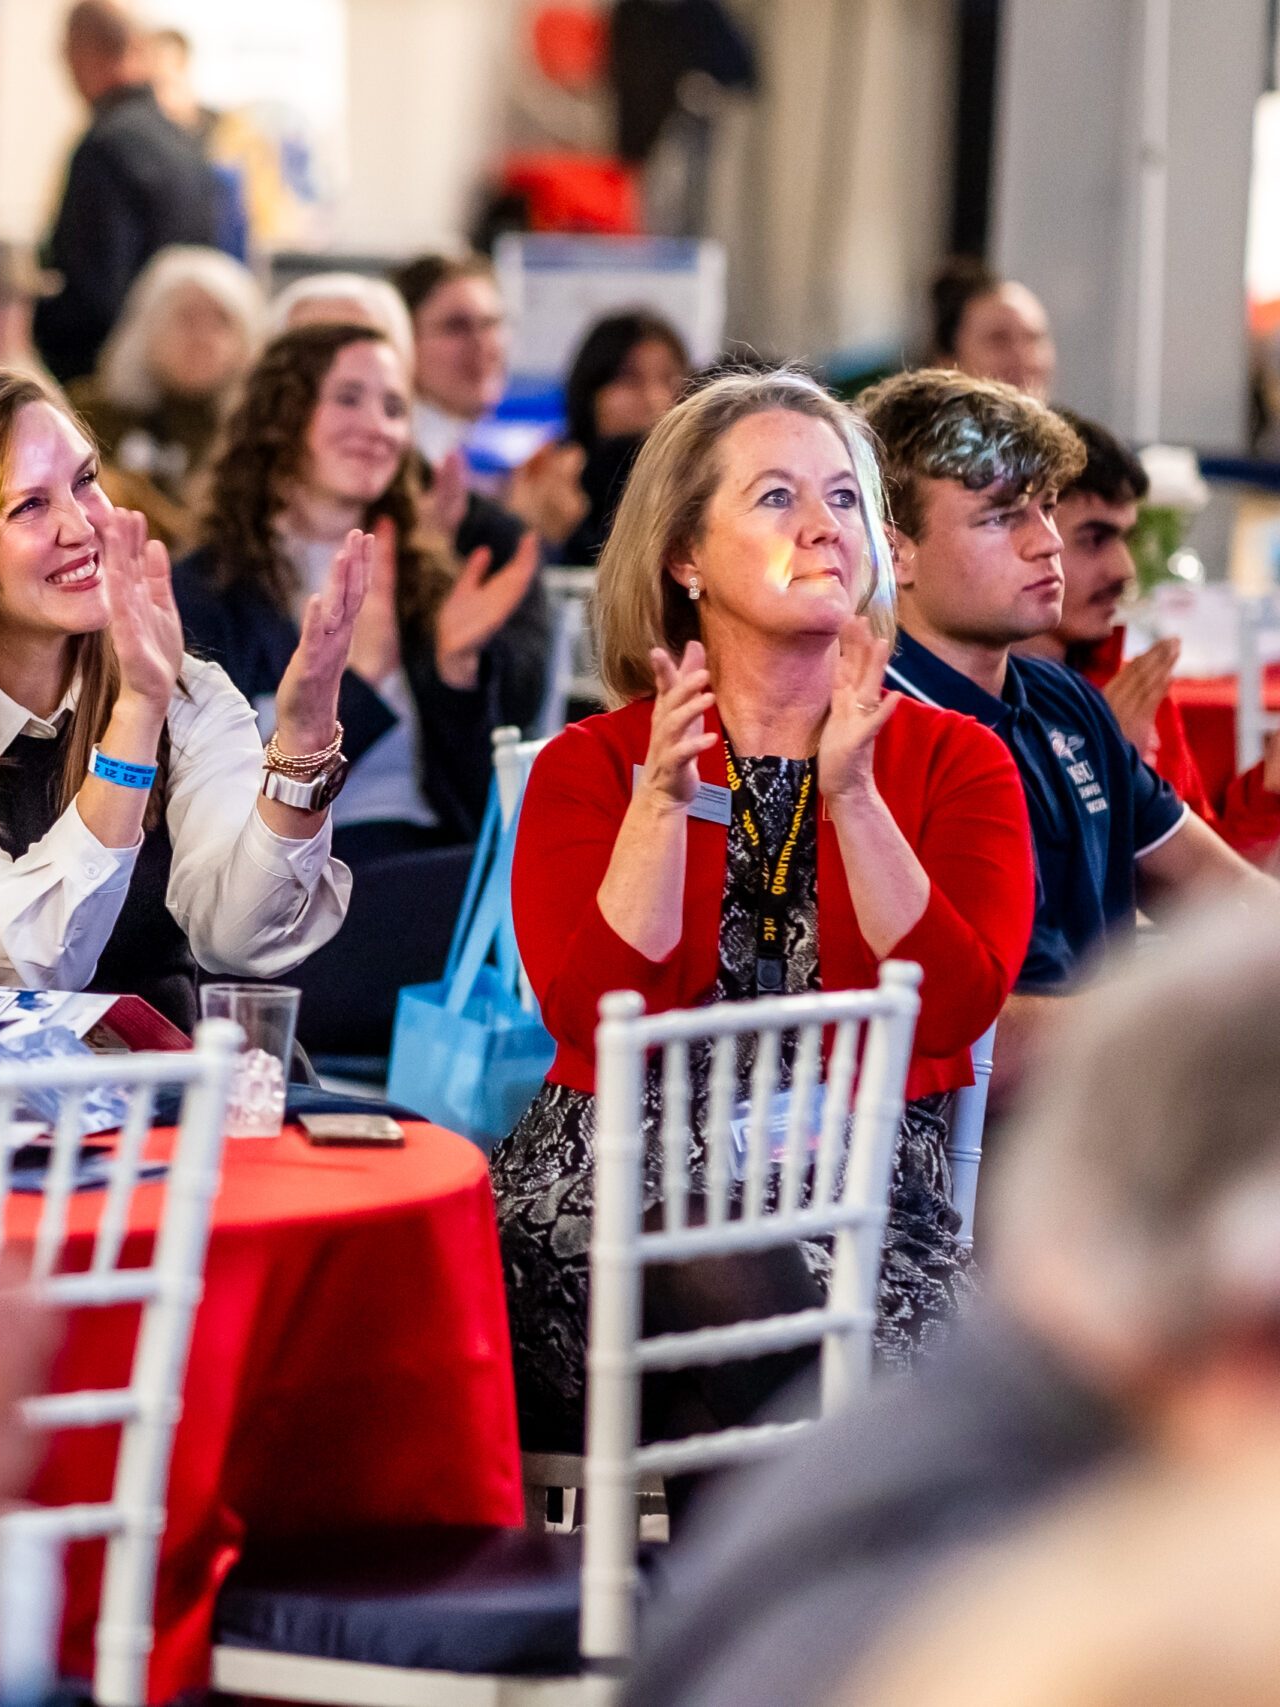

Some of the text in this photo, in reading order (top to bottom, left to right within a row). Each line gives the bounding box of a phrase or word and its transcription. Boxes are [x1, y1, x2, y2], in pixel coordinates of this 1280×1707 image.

[104, 767, 118, 778] 21
[123, 772, 137, 784] 21
[772, 773, 812, 895] goarmy.com/rotc
